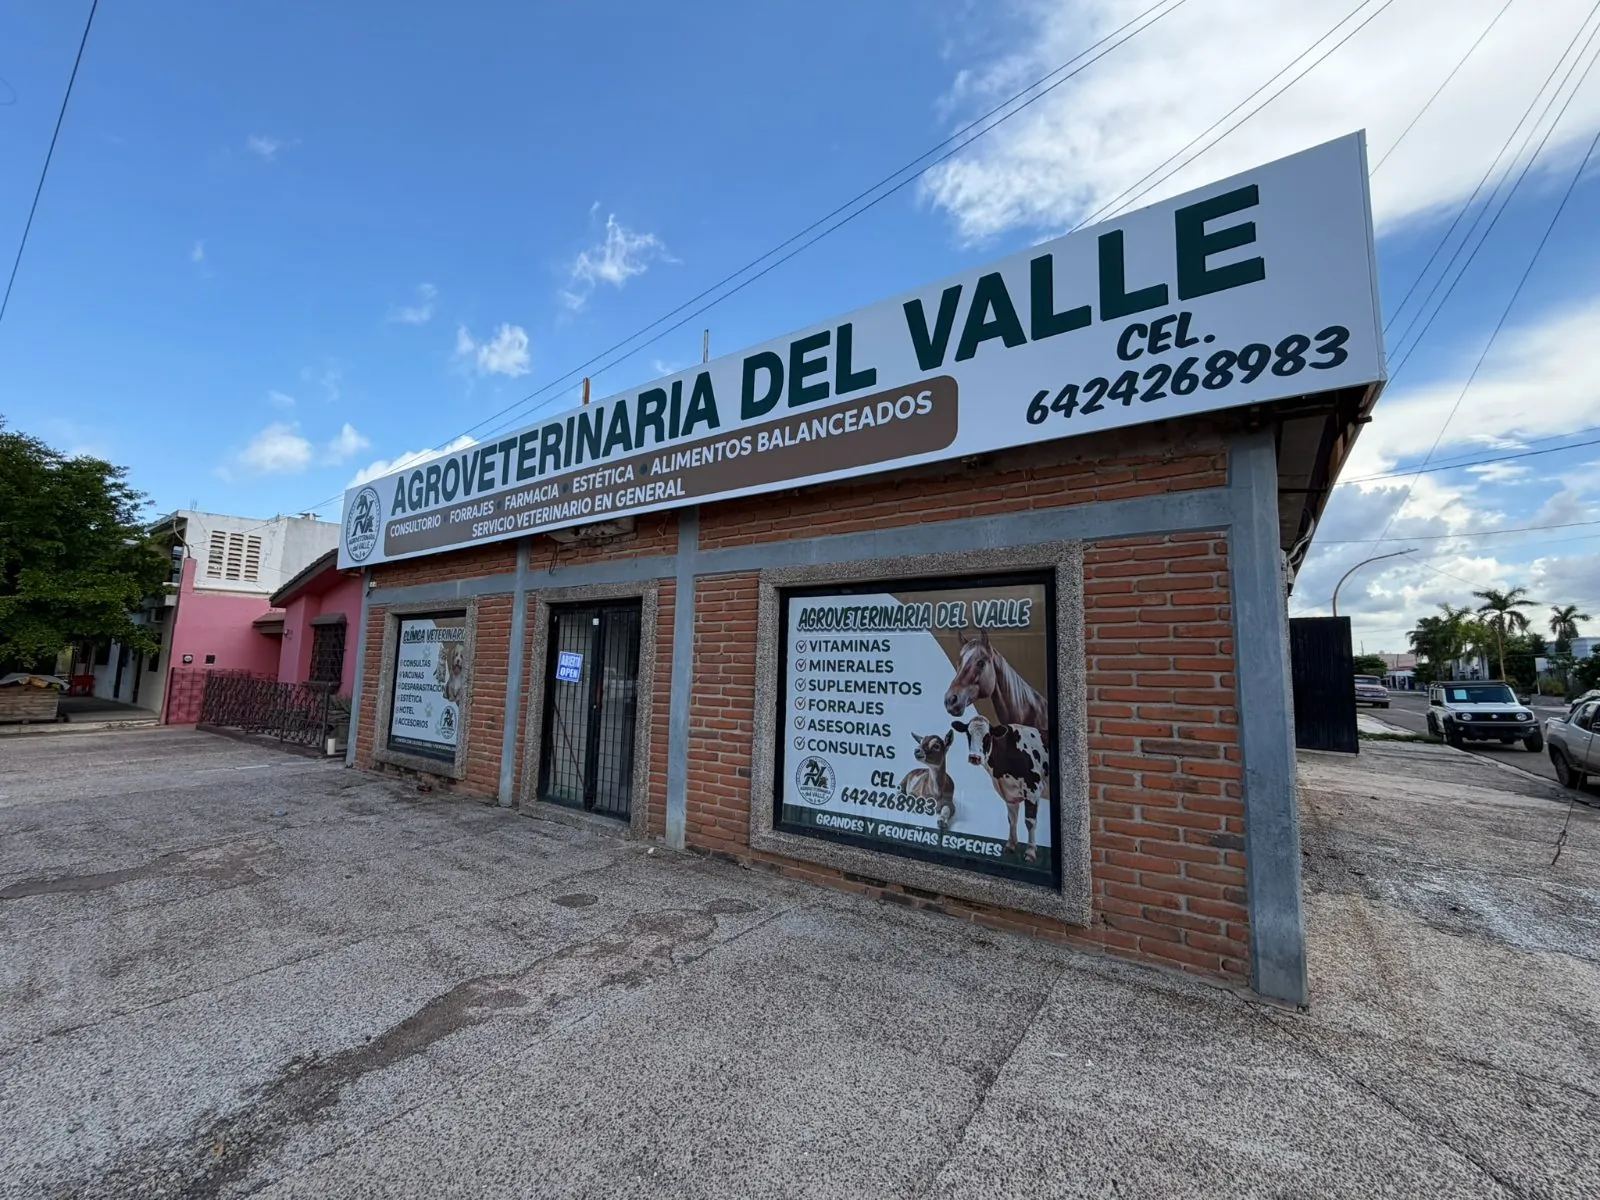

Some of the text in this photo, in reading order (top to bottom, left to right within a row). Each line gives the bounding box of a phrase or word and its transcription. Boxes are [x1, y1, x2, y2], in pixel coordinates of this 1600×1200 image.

[1117, 311, 1216, 361] CEL.
[391, 184, 1265, 516] AGROVETERINARIA DEL VALLE
[1026, 325, 1350, 425] 6424268983
[390, 390, 933, 538] CONSULTORIO FORRAJES FARMACIA ESTÉTICA ALIMENTOS BALANCEADOS
[471, 479, 685, 538] SERVICIO VETERINARIO EN GENERAL
[797, 598, 1032, 631] AGROVETERINARIA DEL VALLE
[809, 639, 891, 652] VITAMINAS
[403, 659, 431, 667] CONSULTAS
[808, 660, 894, 673] MINERALES
[402, 671, 425, 679] VACUNAS
[560, 667, 578, 679] OPEN
[808, 679, 922, 695] SUPLEMENTOS
[399, 706, 415, 715] HOTEL
[808, 699, 884, 715] FORRAJES
[398, 717, 429, 728] ACCESORIOS
[807, 719, 891, 737] ASESORIAS
[807, 739, 896, 760] CONSULTAS
[871, 770, 901, 789] CEL.
[841, 787, 937, 816] 6424268983
[816, 814, 1003, 857] GRANDES Y PEQUEÑAS ESPECIES
